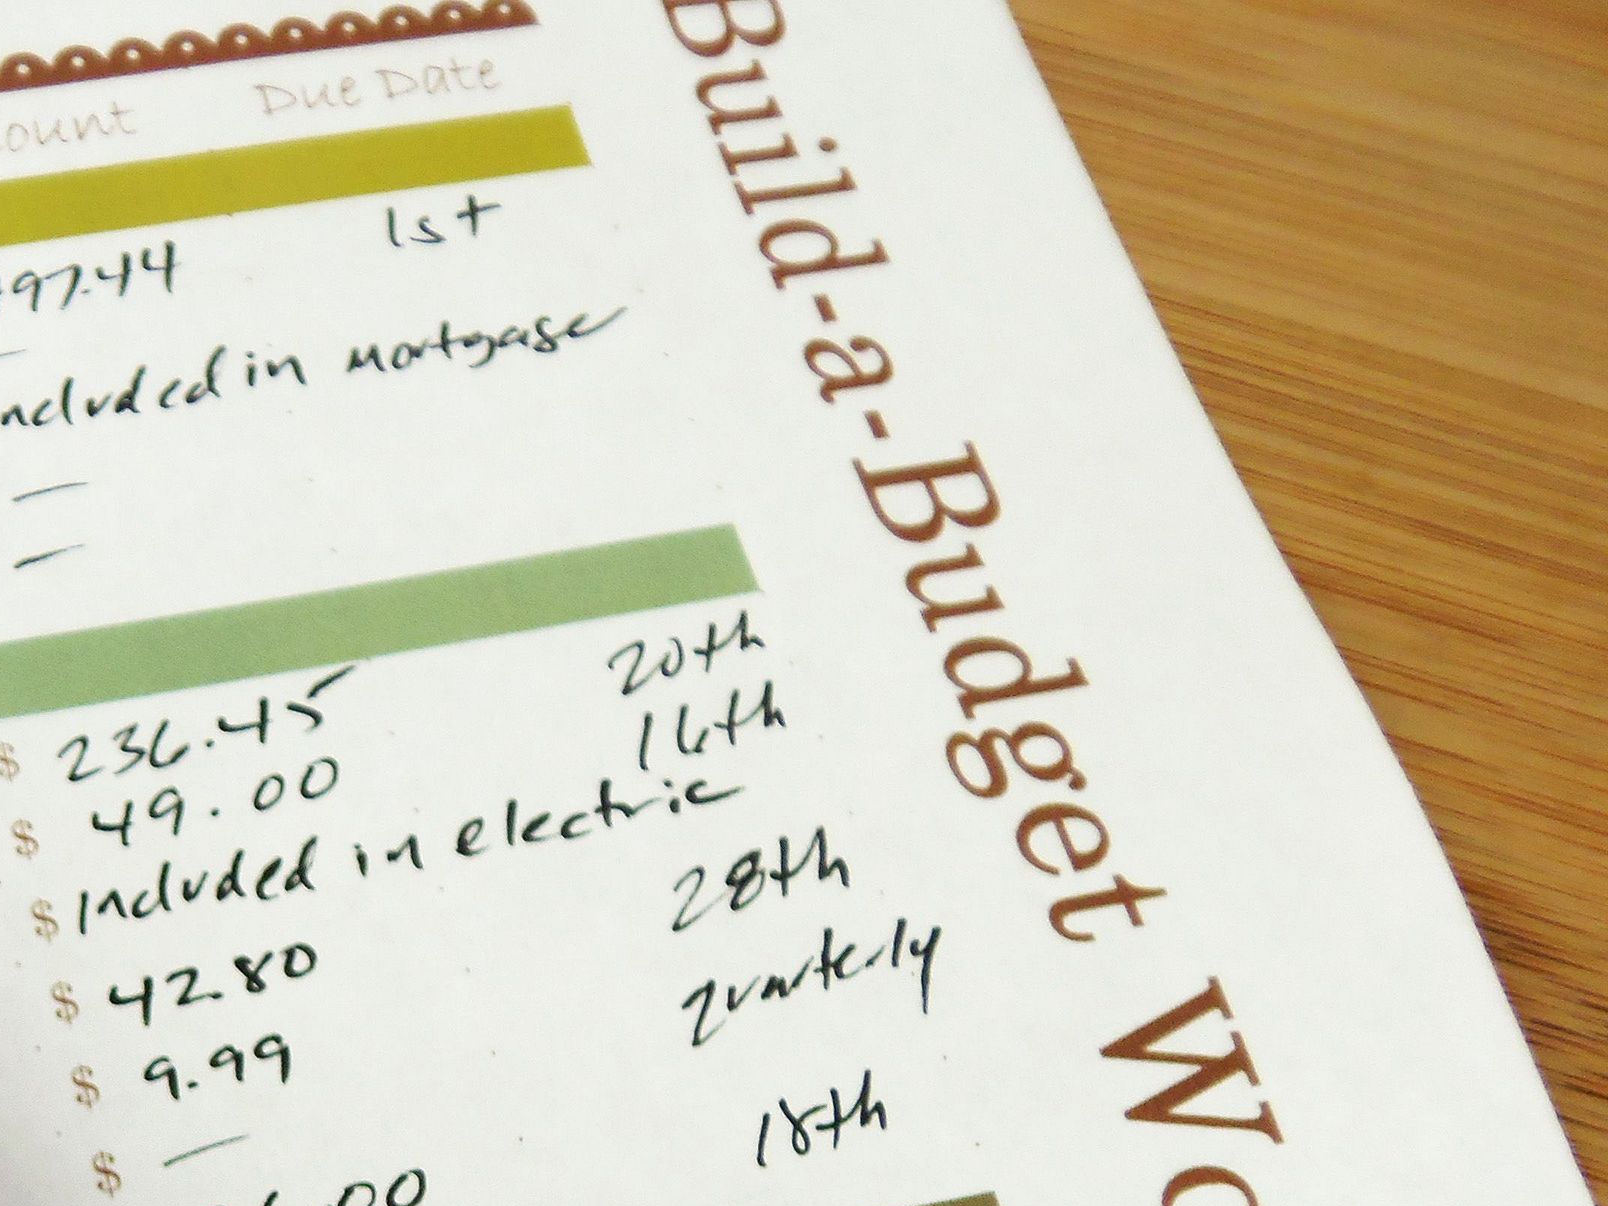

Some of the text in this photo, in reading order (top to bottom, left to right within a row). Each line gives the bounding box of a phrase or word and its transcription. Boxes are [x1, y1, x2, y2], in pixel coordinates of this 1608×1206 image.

[254, 56, 502, 117] Due Date
[386, 195, 503, 247] 1st
[244, 350, 308, 386] in
[662, 0, 1167, 943] Build-a-Budget
[608, 610, 766, 697] 20th
[57, 666, 356, 783] 236.45
[638, 680, 786, 770] 16th
[11, 821, 40, 857] $
[92, 757, 340, 845] 49.00
[354, 836, 423, 877] in
[455, 777, 745, 857] electric
[671, 826, 850, 933] 28th
[31, 899, 59, 939] $
[50, 982, 78, 1024] $
[108, 942, 317, 1026] 42.80
[71, 1066, 100, 1107] $
[143, 1033, 292, 1101] 9.99
[757, 1068, 886, 1166] 18th
[92, 1152, 122, 1196] $
